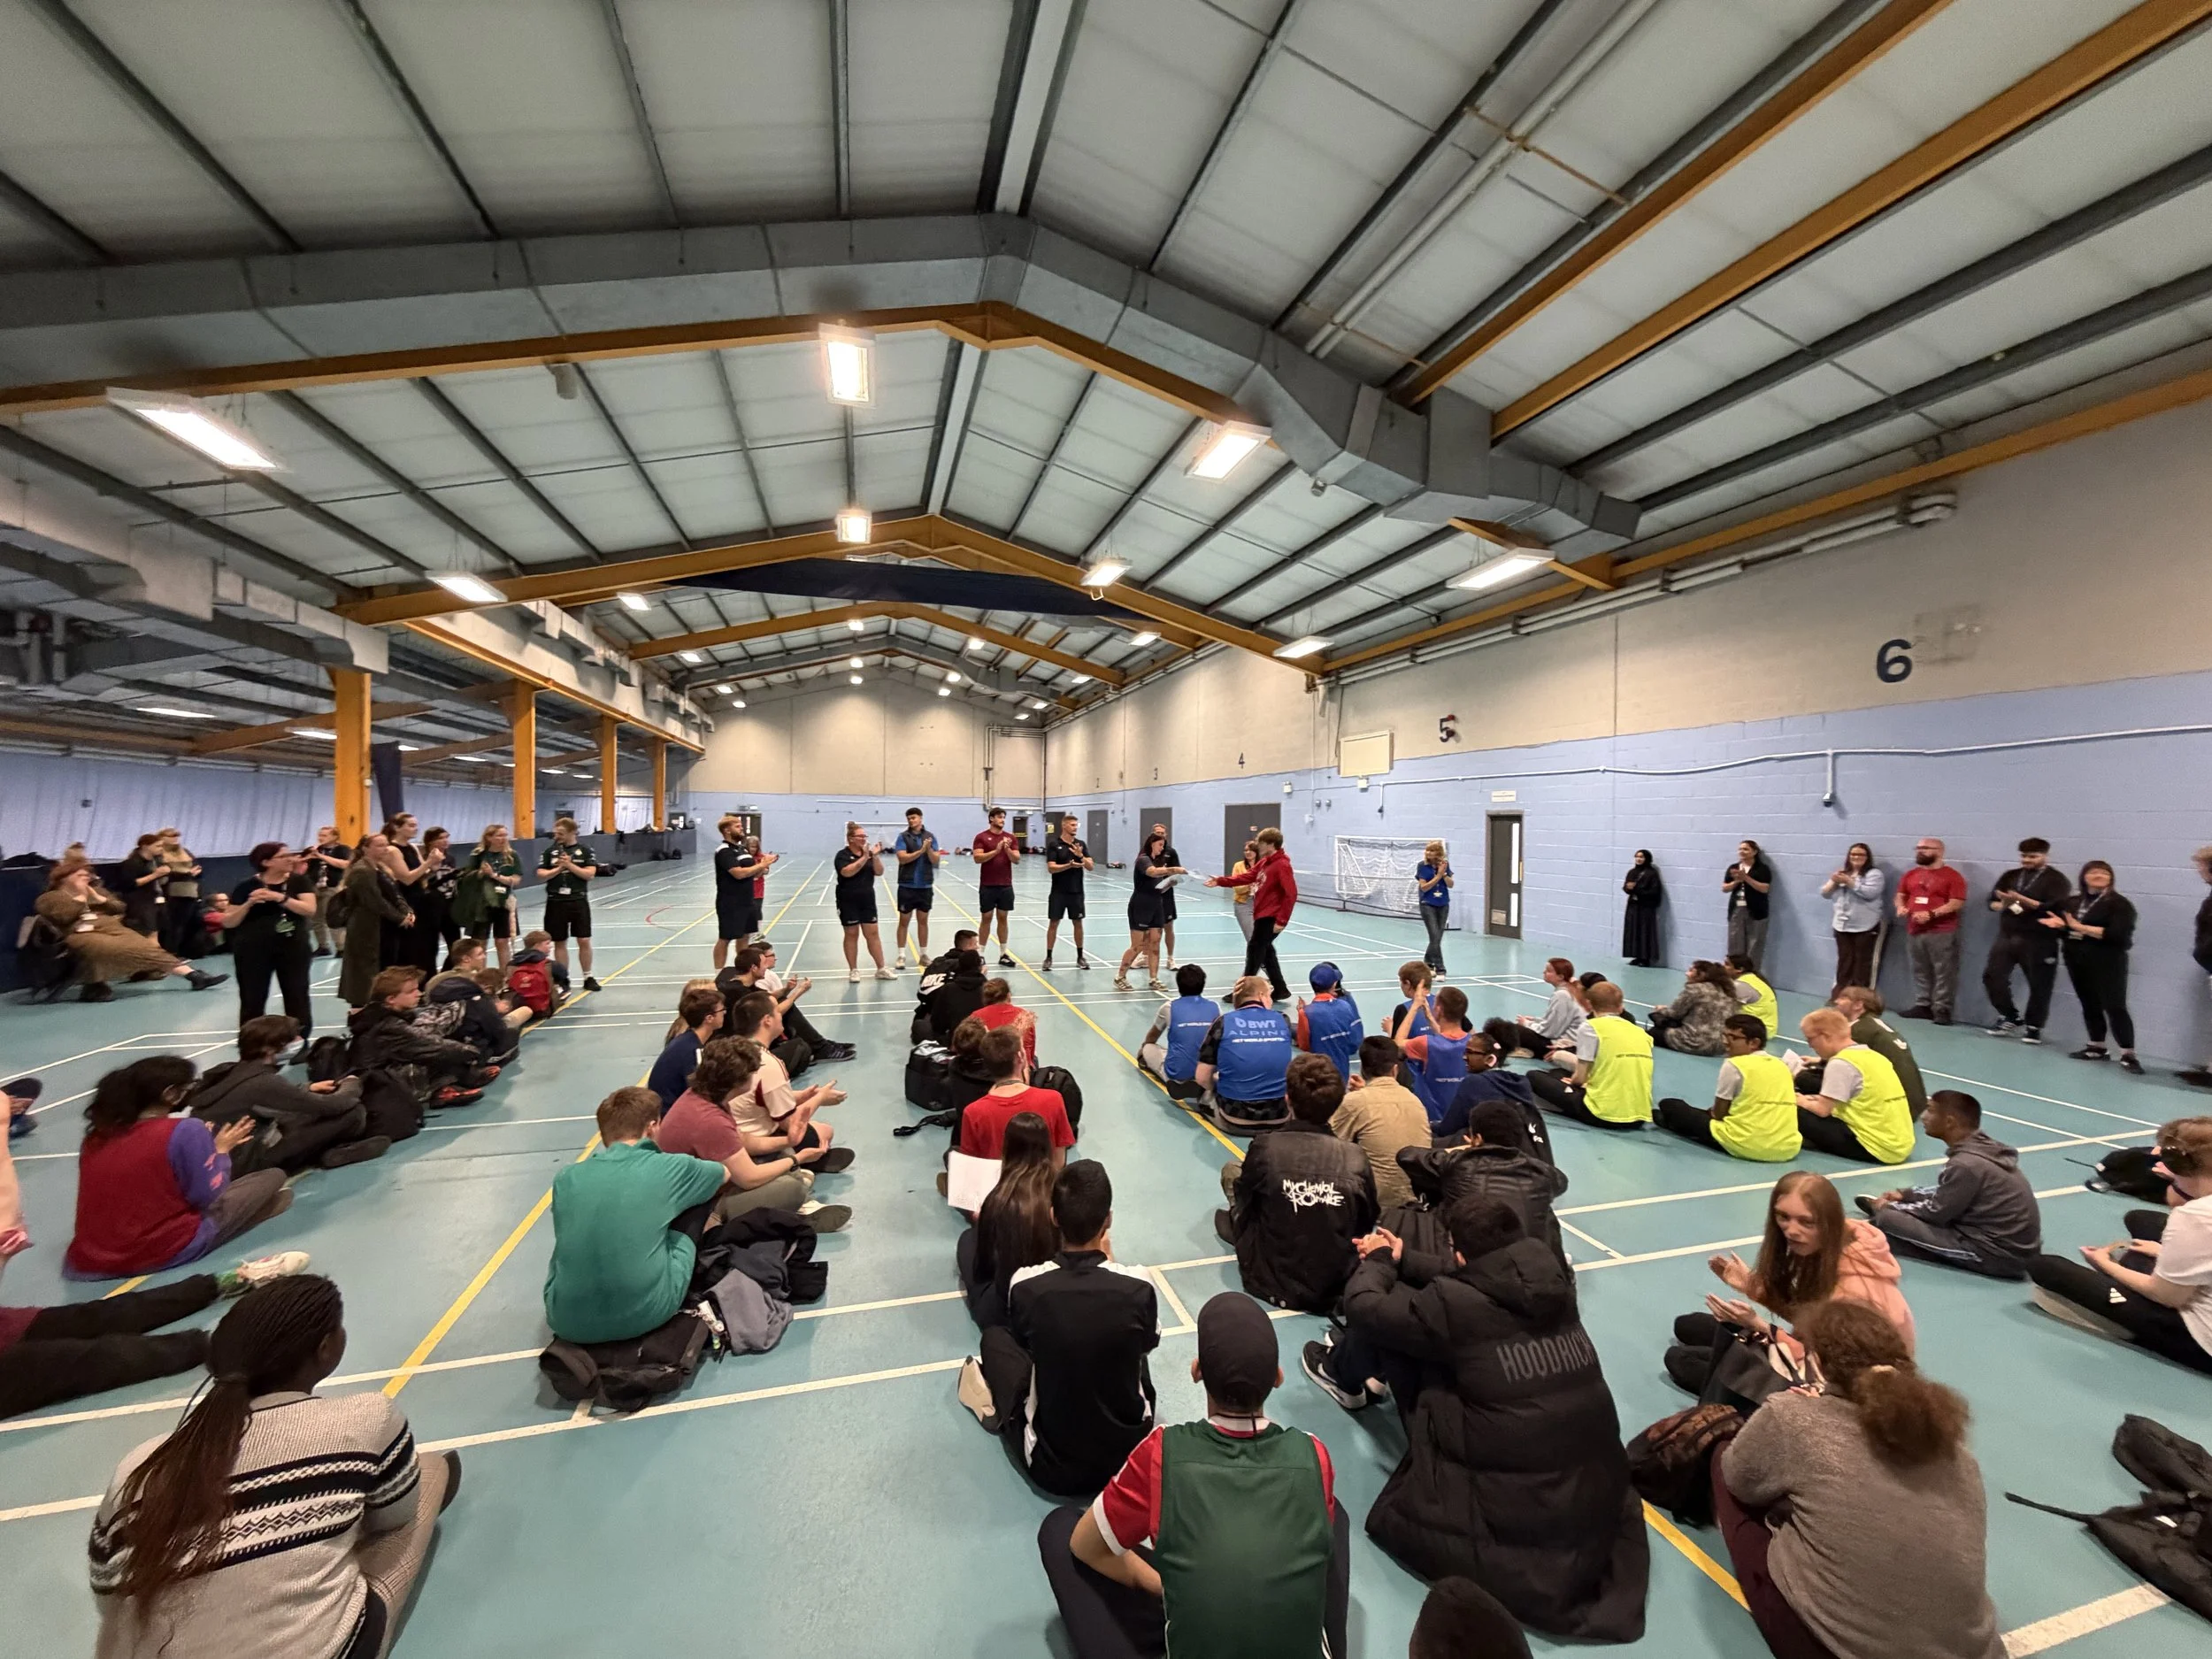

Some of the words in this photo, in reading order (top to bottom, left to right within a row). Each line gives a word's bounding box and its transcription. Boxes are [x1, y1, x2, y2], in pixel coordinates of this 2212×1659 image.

[1876, 639, 1913, 683] 6
[1439, 715, 1455, 742] 5
[1238, 752, 1245, 769] 4
[1248, 1019, 1276, 1028] BWT
